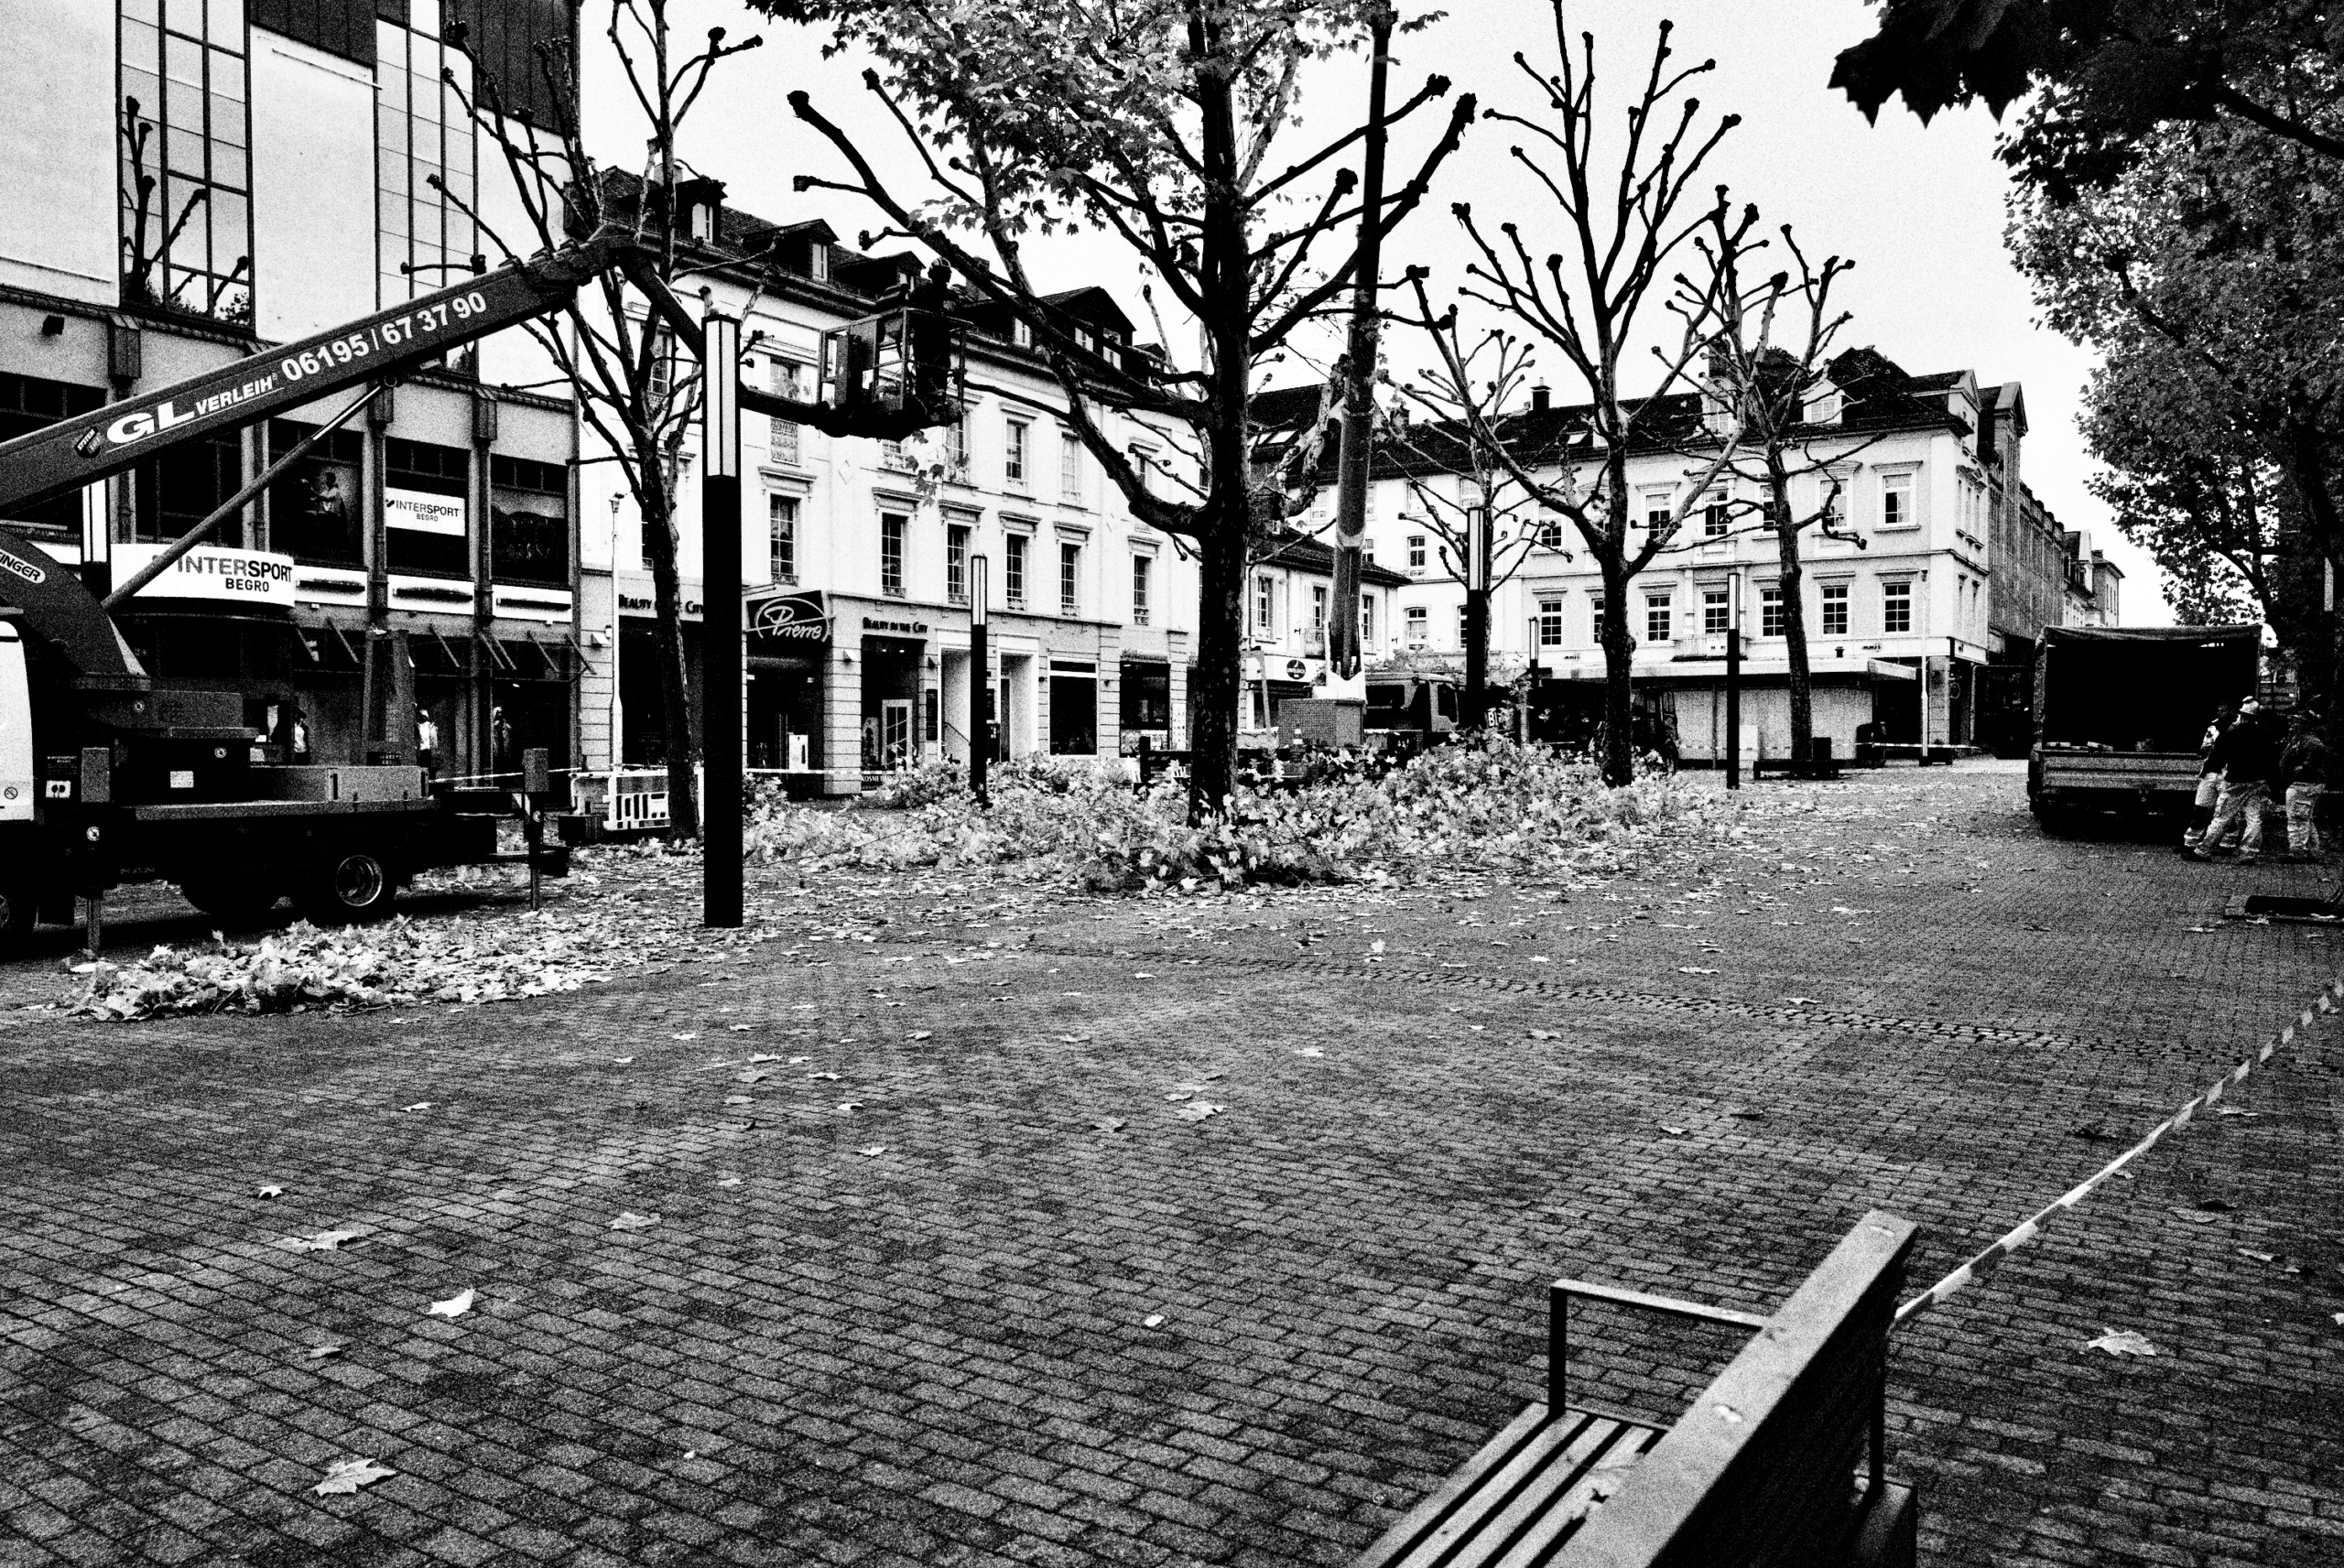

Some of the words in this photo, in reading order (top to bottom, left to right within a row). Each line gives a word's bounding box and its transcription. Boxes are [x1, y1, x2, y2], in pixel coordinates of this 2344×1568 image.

[106, 401, 195, 444] GL
[195, 377, 274, 415] VERLEIH
[281, 333, 370, 382] 06195
[380, 317, 413, 345] 67
[417, 304, 448, 332] 37
[452, 291, 487, 319] 90
[396, 500, 460, 518] INTERSPORT
[416, 513, 439, 523] BEGRO
[178, 555, 293, 583] INTERSPORT
[225, 578, 270, 592] BEGRO
[763, 605, 823, 640] Pierre
